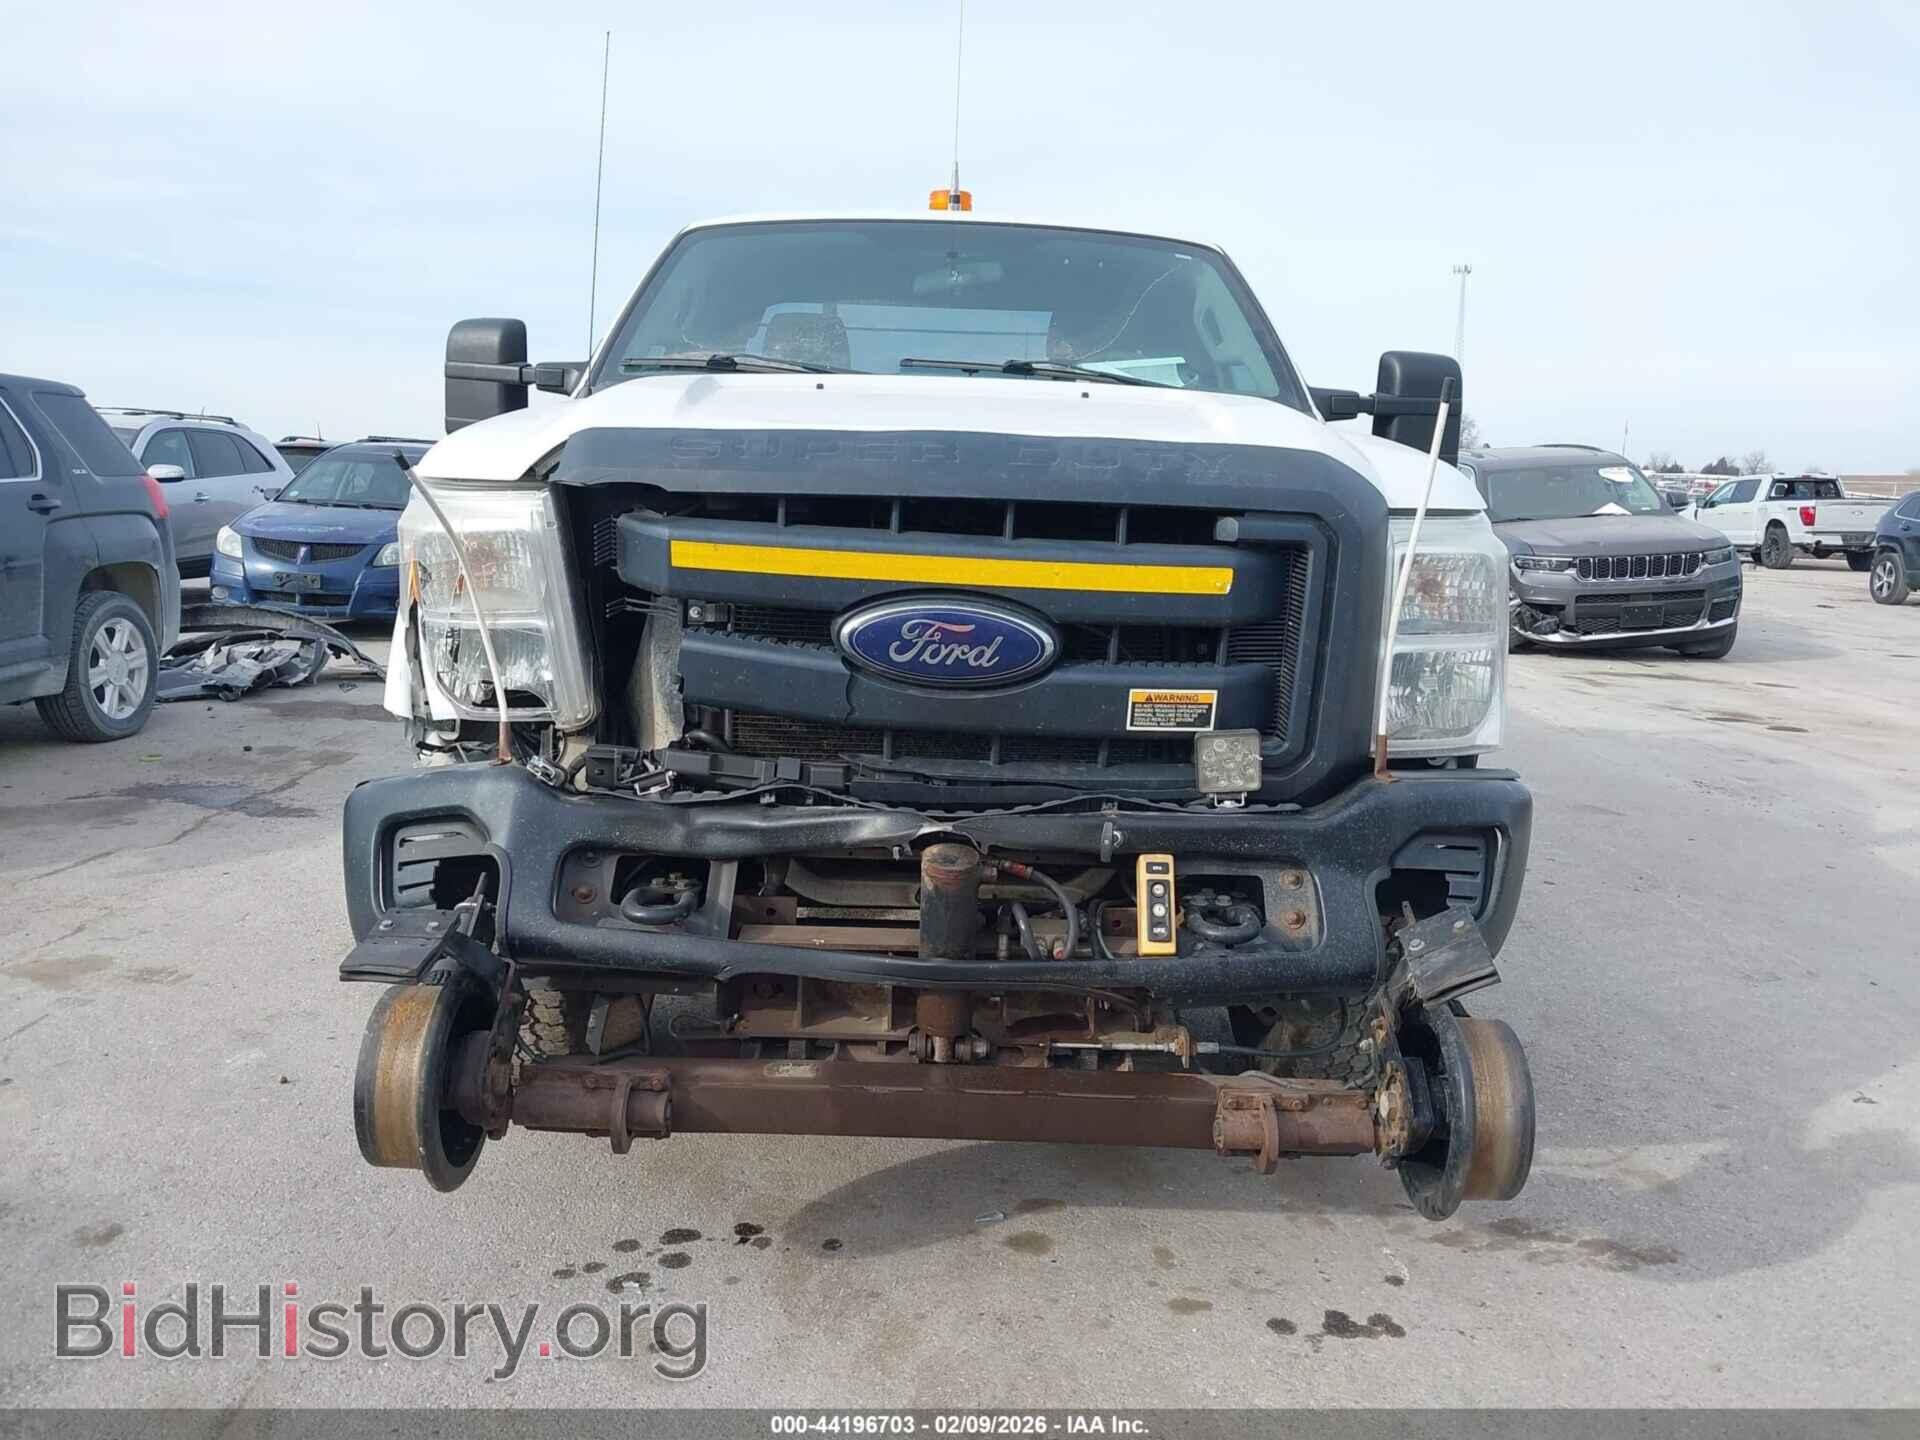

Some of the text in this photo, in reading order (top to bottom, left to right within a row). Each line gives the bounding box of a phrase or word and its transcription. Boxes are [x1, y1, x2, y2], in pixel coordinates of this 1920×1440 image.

[670, 435, 1233, 479] SUPER DUTY
[888, 619, 1004, 668] Ford
[1154, 694, 1199, 703] WARNING
